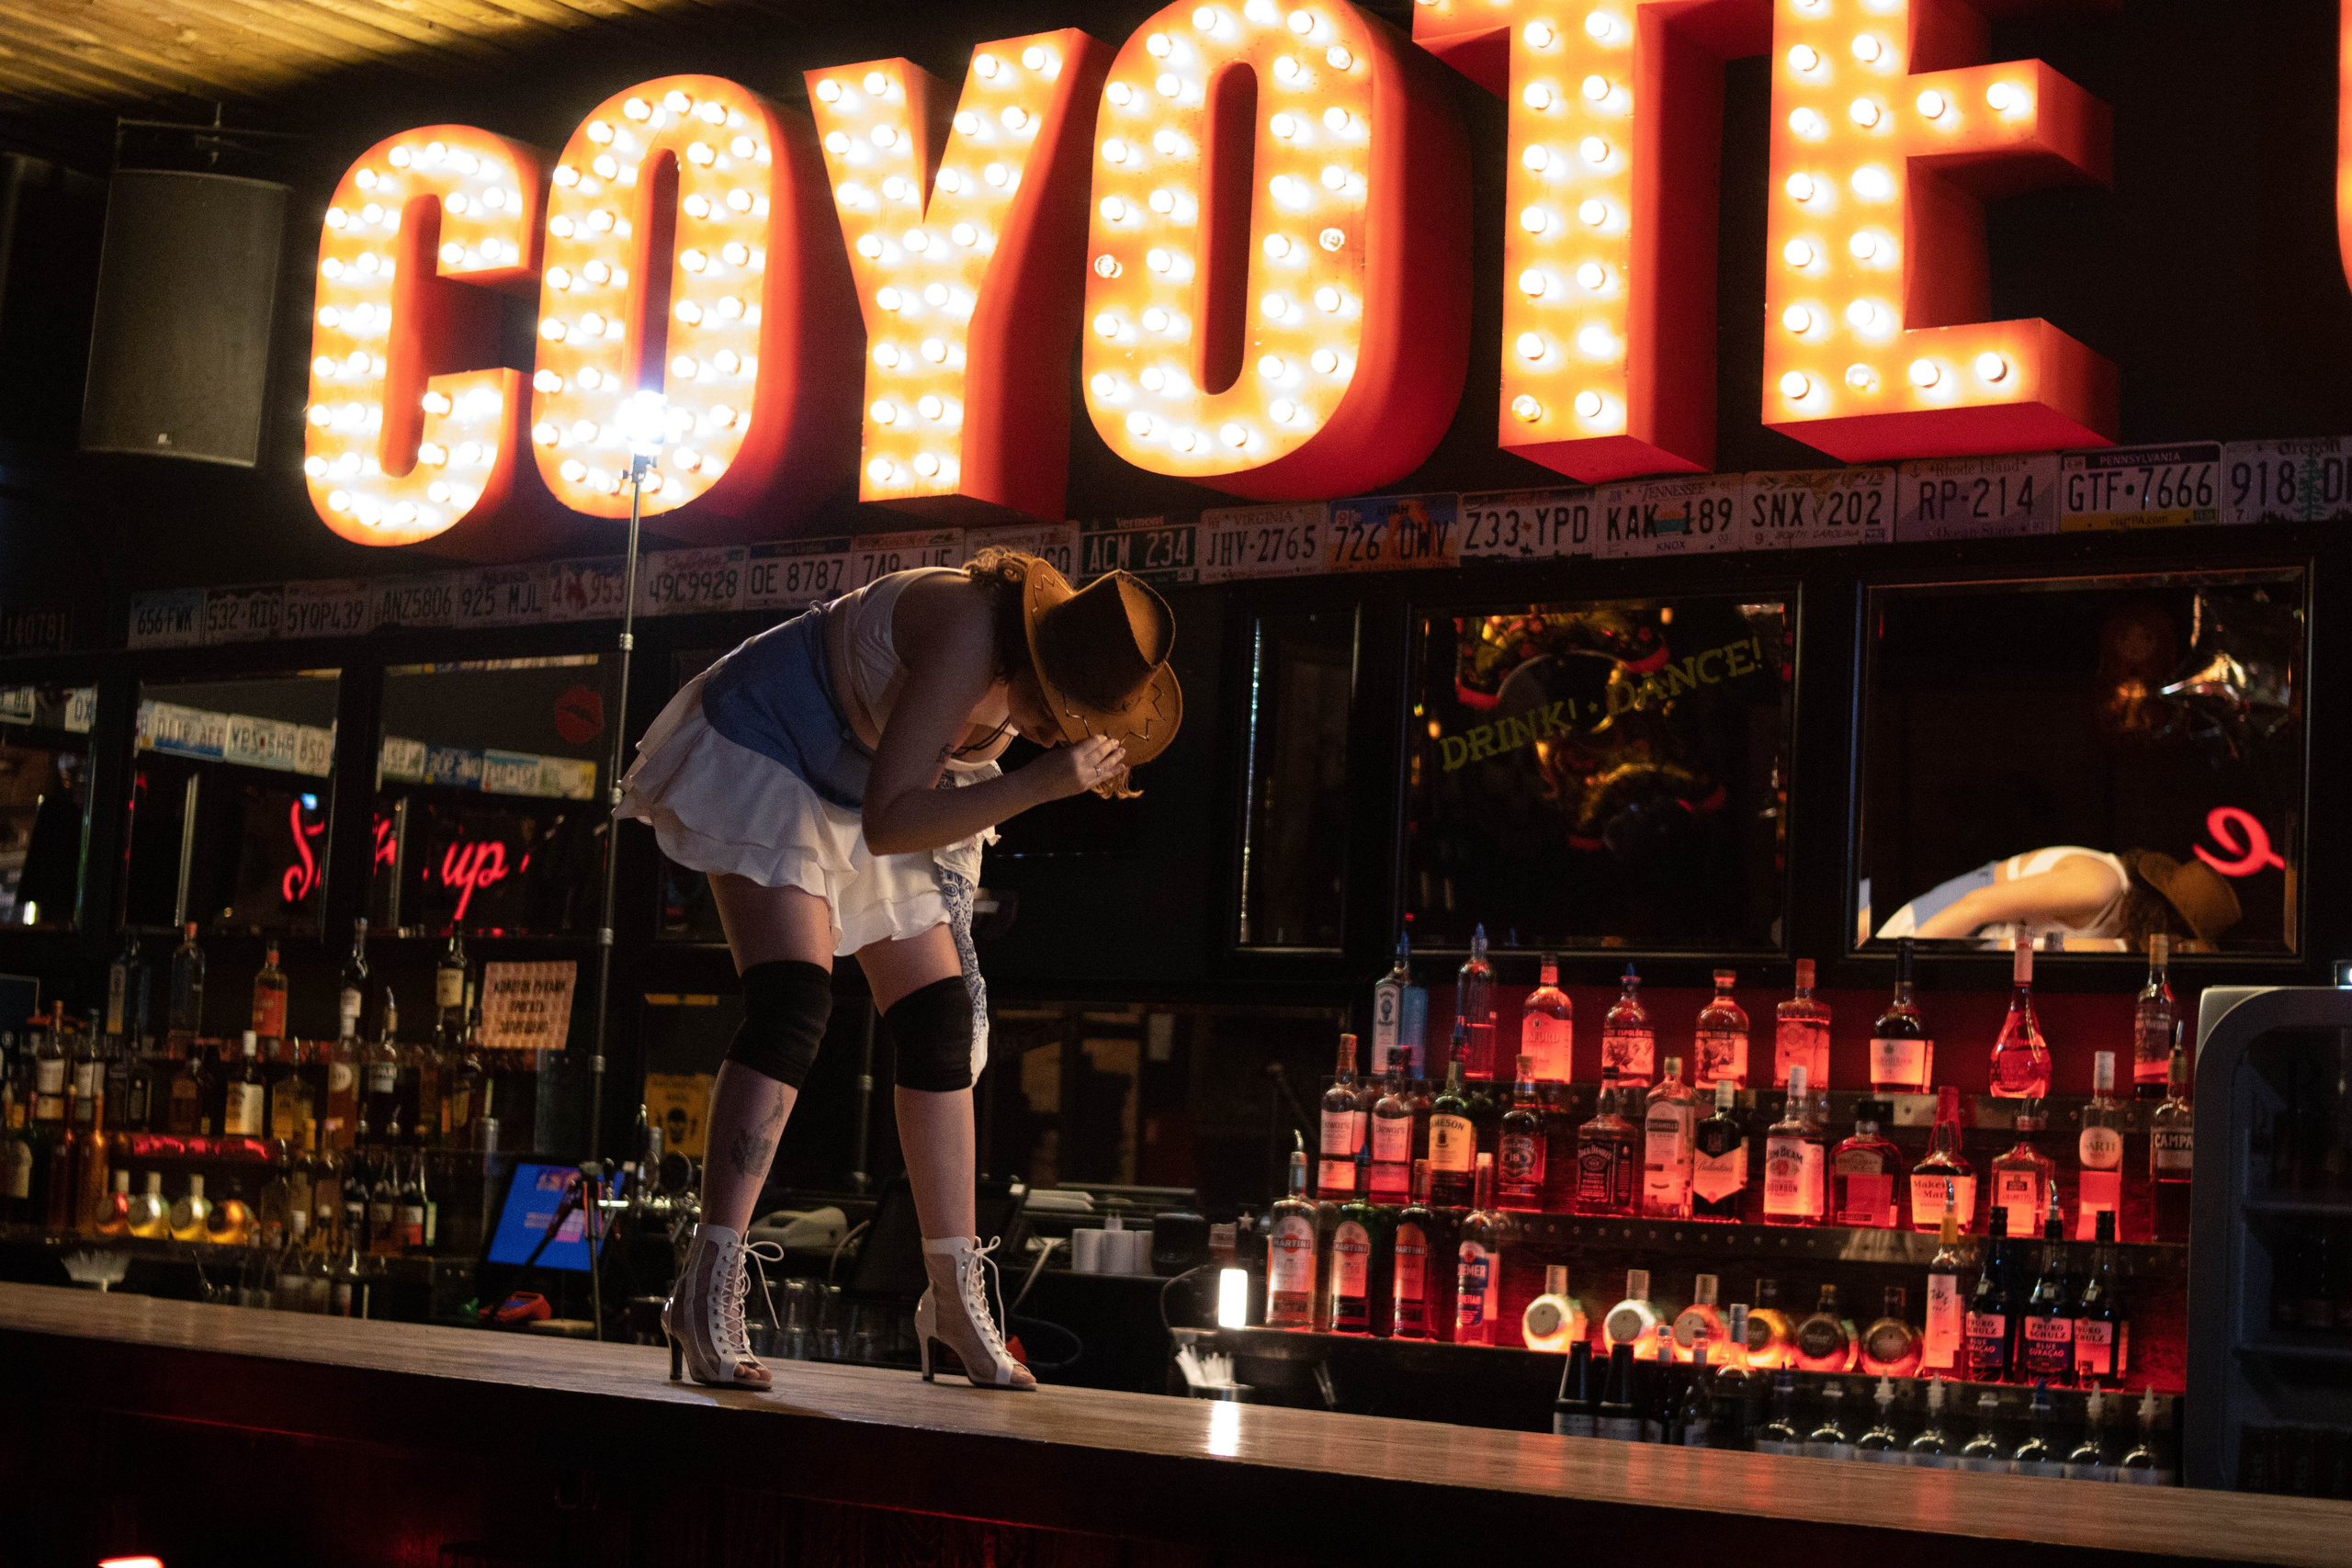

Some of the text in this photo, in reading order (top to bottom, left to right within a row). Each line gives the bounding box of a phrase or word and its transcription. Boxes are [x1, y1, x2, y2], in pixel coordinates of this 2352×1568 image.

[303, 0, 2058, 547] COYOTE
[2277, 440, 2341, 457] Oregon
[2099, 451, 2181, 466] PENNSYLVANIA
[1936, 460, 2019, 477] Rhode Island
[1639, 483, 1705, 502] TENNESSEE
[2231, 461, 2296, 506] 918
[1919, 476, 2034, 521] RP-214
[1379, 505, 1408, 516] UTAH
[1752, 491, 1882, 527] SNX 202
[1115, 515, 1164, 529] Vermont
[1234, 511, 1294, 526] VIRGINIA
[1608, 498, 1733, 541] KAK 189
[1089, 534, 1132, 571] ACM
[1145, 529, 1189, 568] 234
[1335, 525, 1381, 561] 726
[1656, 541, 1687, 551] KNOX
[786, 559, 843, 592] 8787
[461, 584, 542, 616] 925 MJL
[1440, 637, 1763, 773] DRINK! DANCE!
[1430, 1118, 1464, 1131] AMESON
[2154, 1134, 2194, 1148] CAMPA
[1273, 1238, 1310, 1248] MARTINI
[1335, 1243, 1368, 1253] MARTINI
